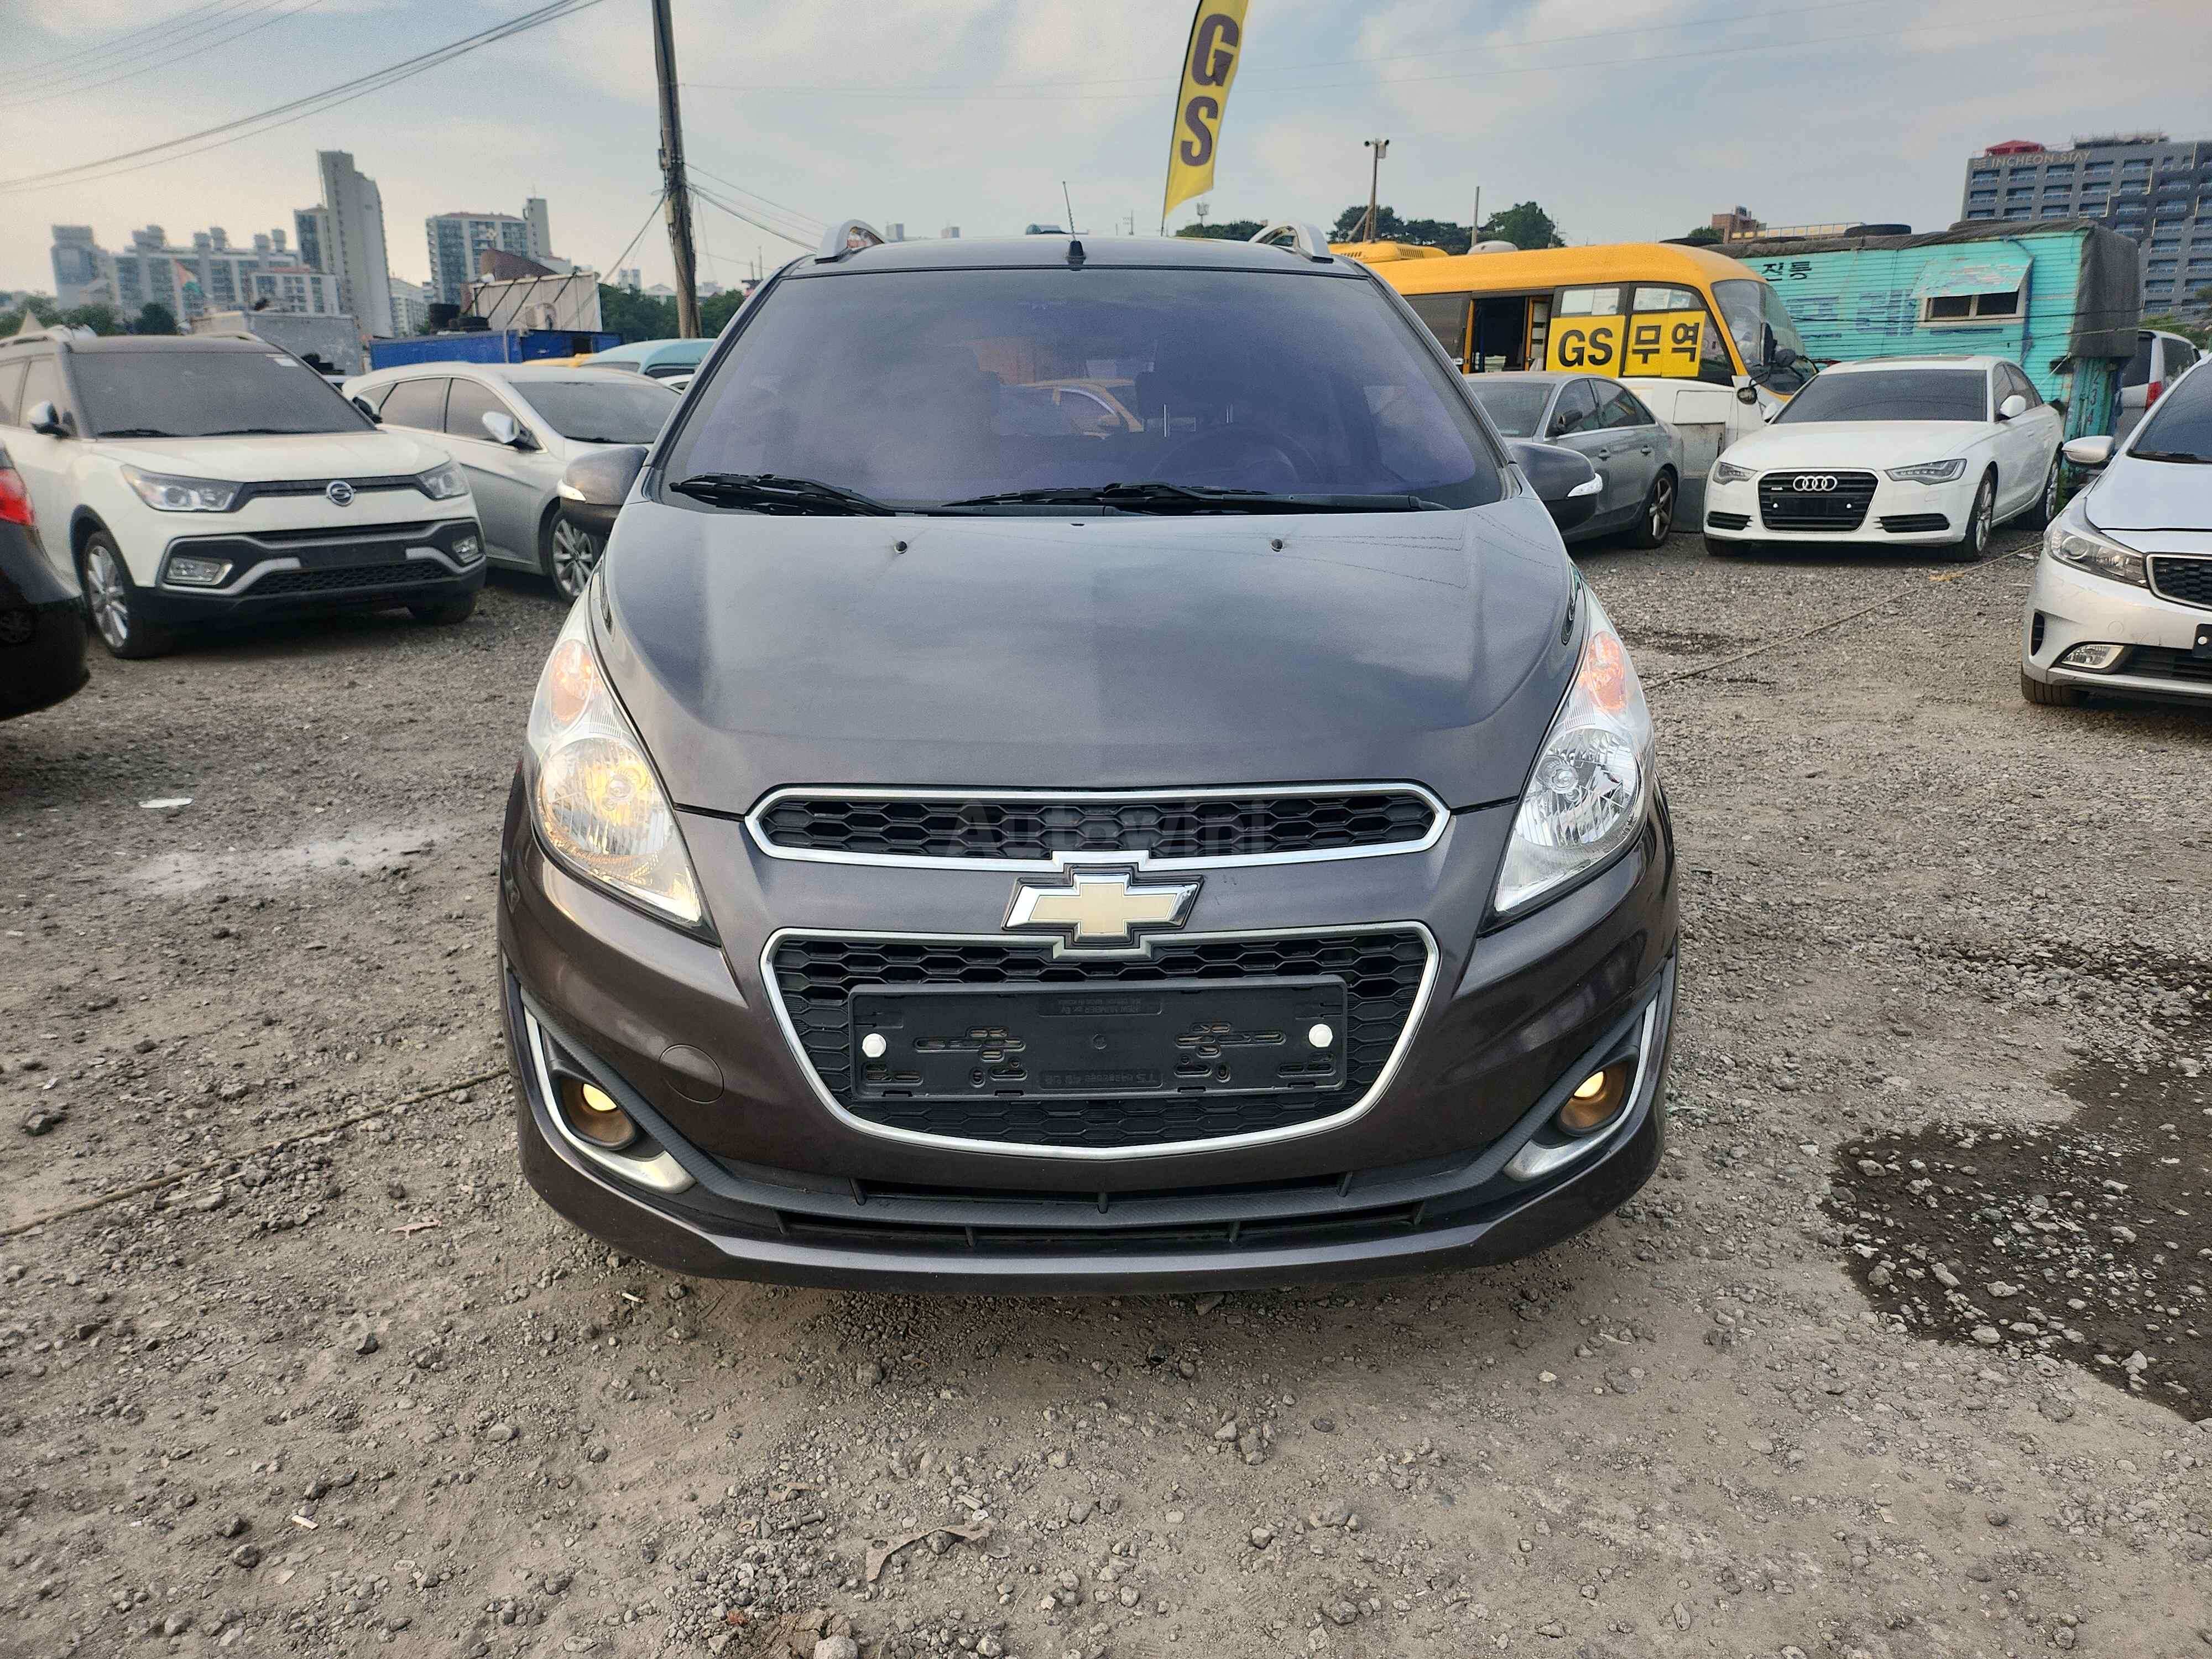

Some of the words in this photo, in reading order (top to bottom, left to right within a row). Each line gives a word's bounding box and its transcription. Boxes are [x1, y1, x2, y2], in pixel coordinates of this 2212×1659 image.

[1181, 14, 1239, 166] GS
[1991, 153, 2054, 168] INCHEON
[2060, 150, 2093, 163] STAY
[1558, 327, 1613, 367] GS
[1632, 322, 1700, 364] 무역
